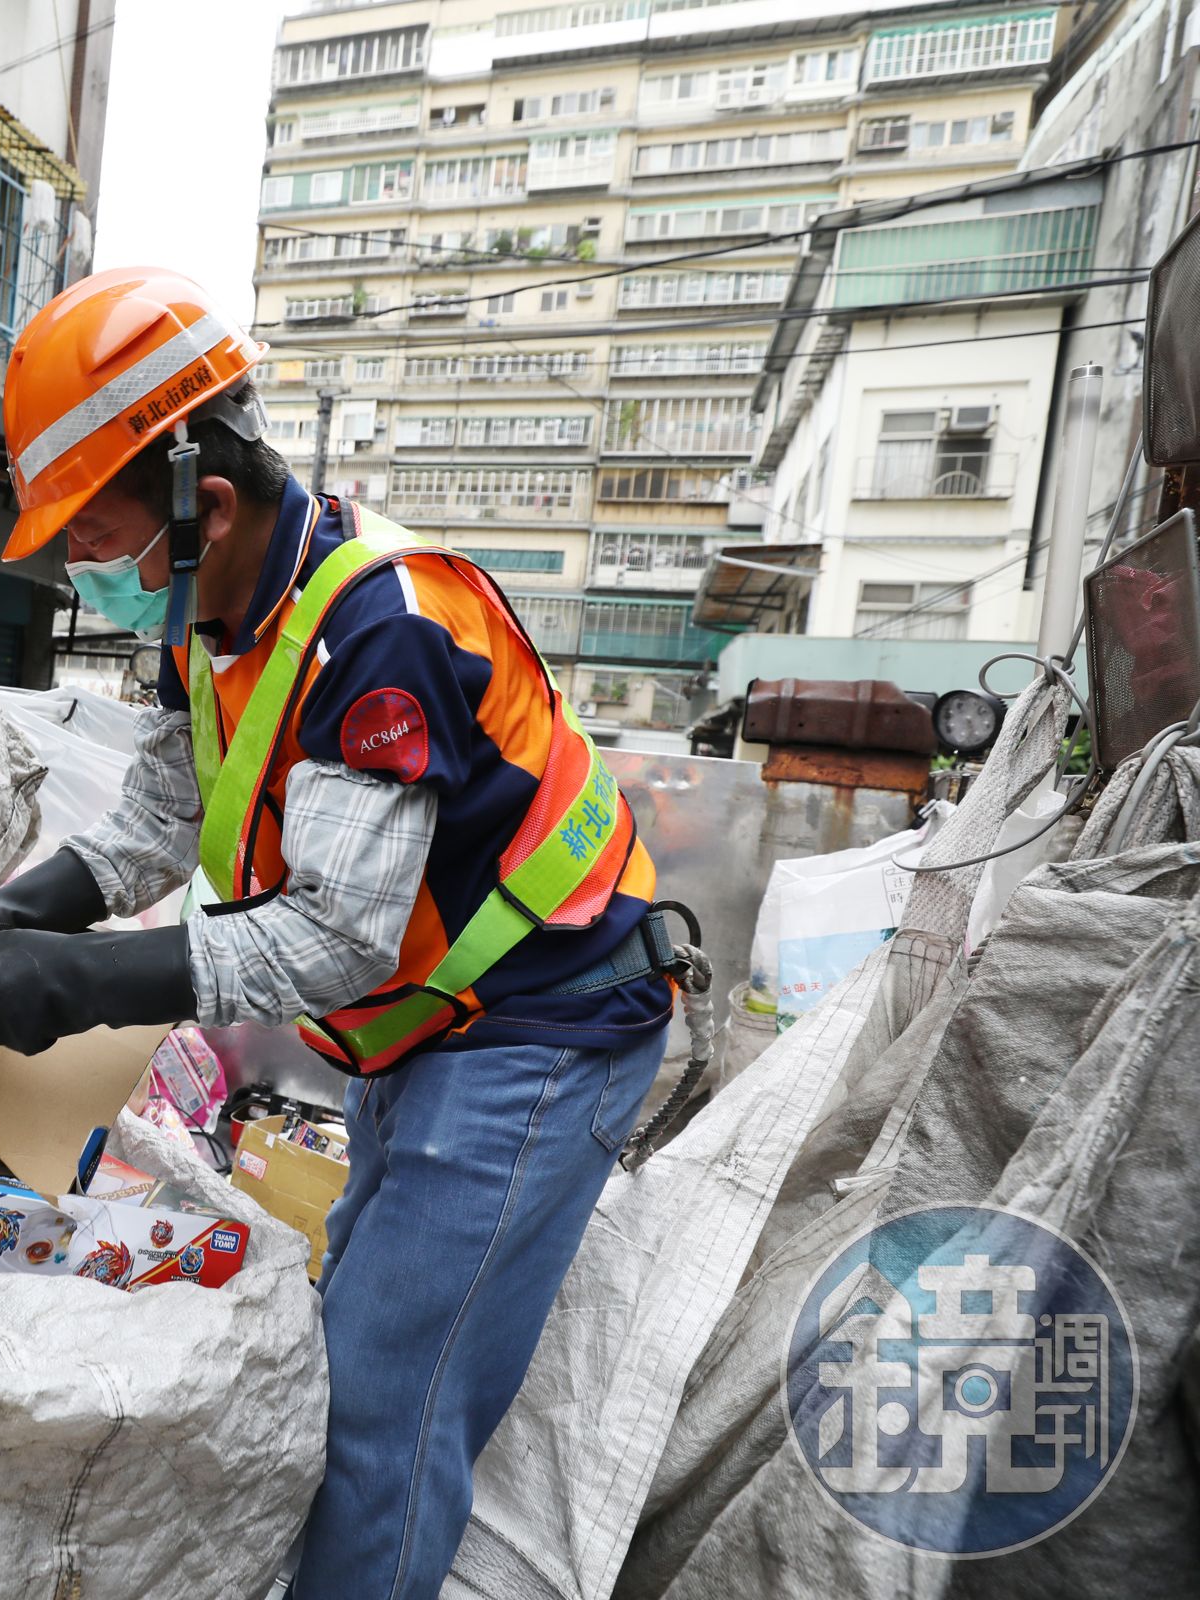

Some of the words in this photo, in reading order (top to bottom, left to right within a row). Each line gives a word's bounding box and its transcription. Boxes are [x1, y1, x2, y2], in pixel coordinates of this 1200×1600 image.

[127, 364, 213, 434] 新北市政府
[360, 720, 410, 754] AC8644
[213, 1240, 236, 1250] TOMY
[214, 1232, 237, 1243] TAKARA
